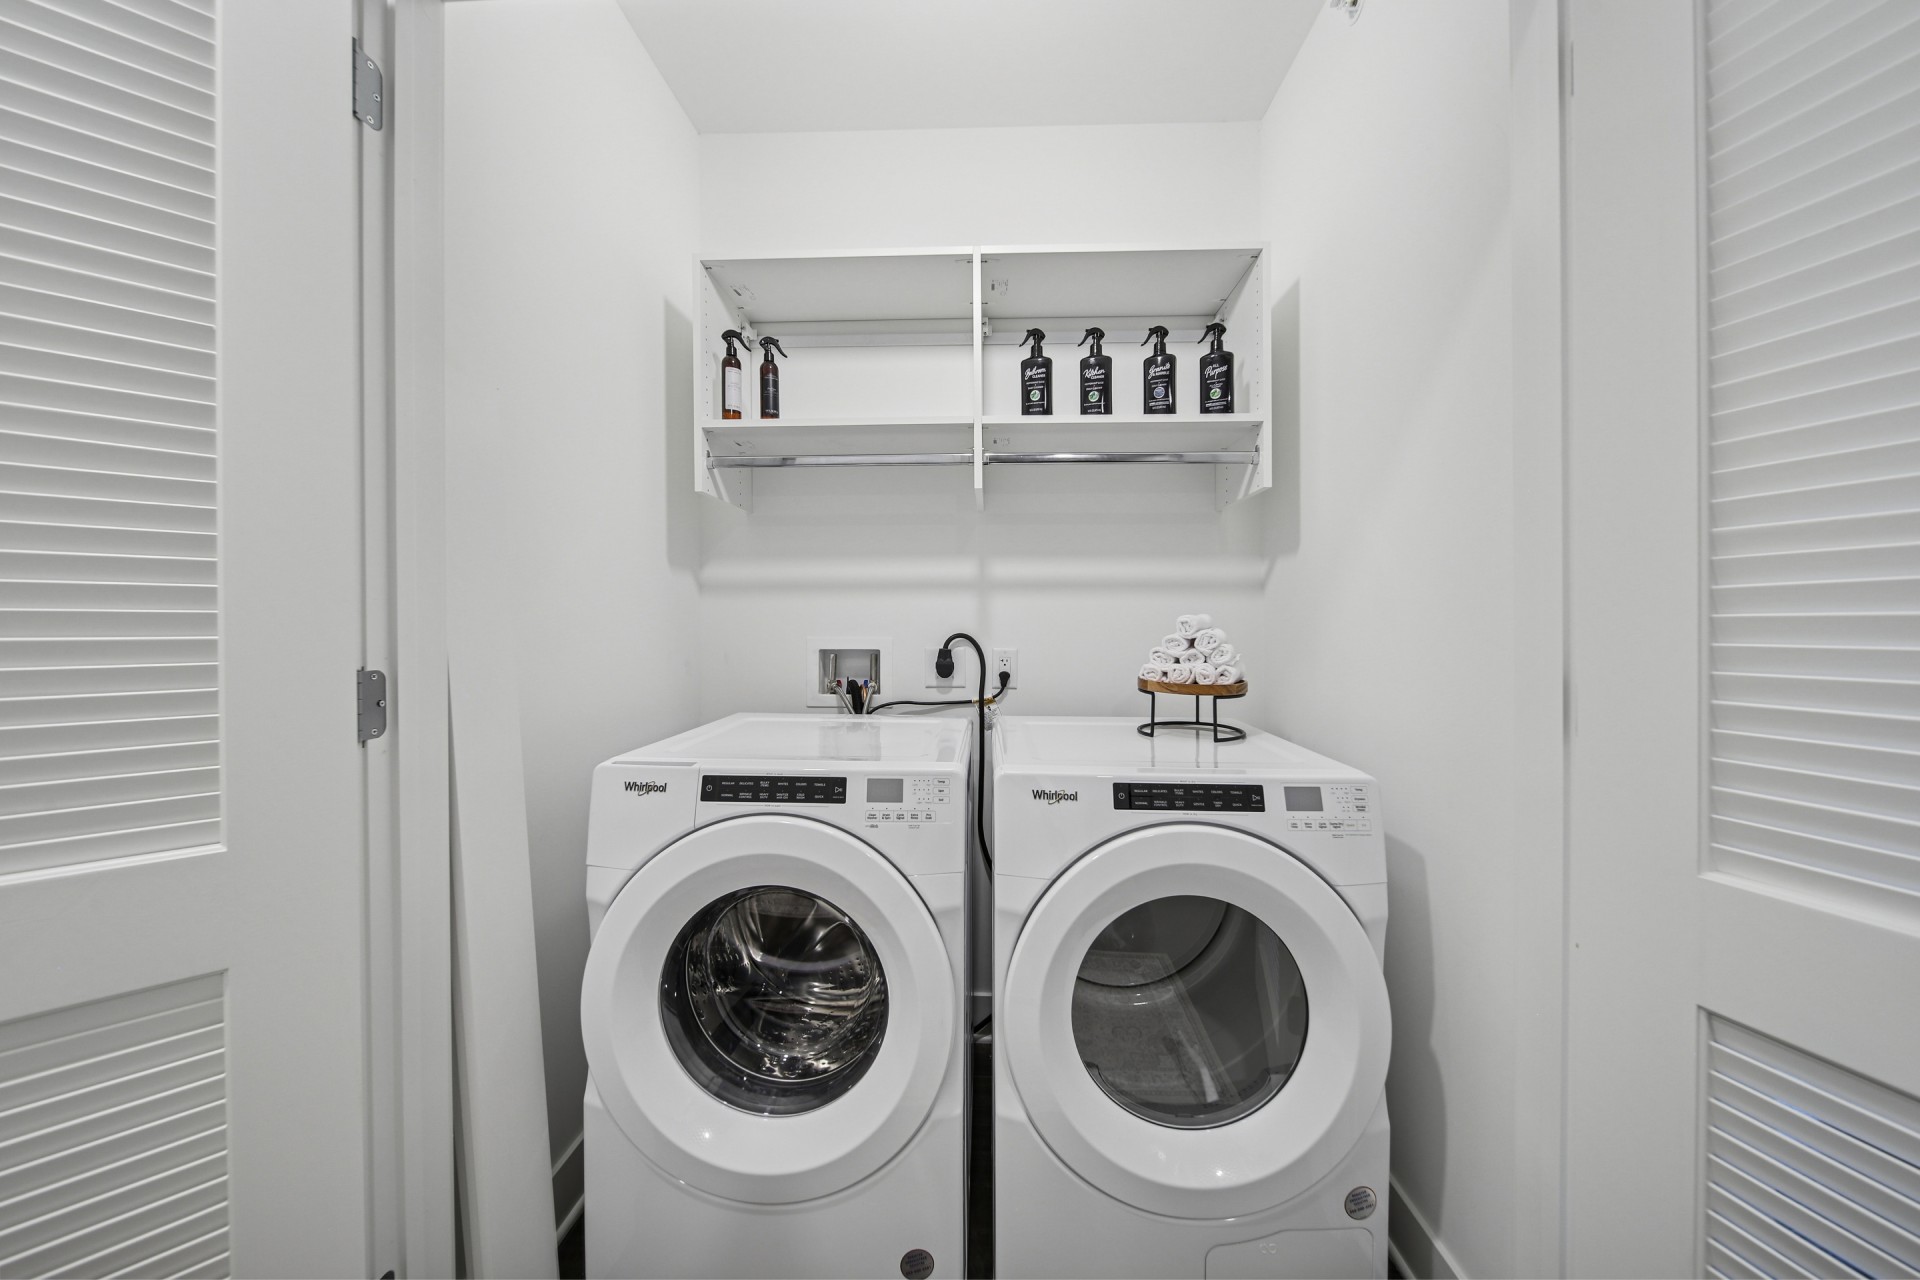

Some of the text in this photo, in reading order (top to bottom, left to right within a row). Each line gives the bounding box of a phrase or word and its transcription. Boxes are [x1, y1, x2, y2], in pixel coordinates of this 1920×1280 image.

[1083, 366, 1106, 379] Kitchen
[1204, 364, 1228, 380] Purpose
[624, 780, 667, 796] Whirlpool
[1032, 790, 1078, 805] Whirlpool
